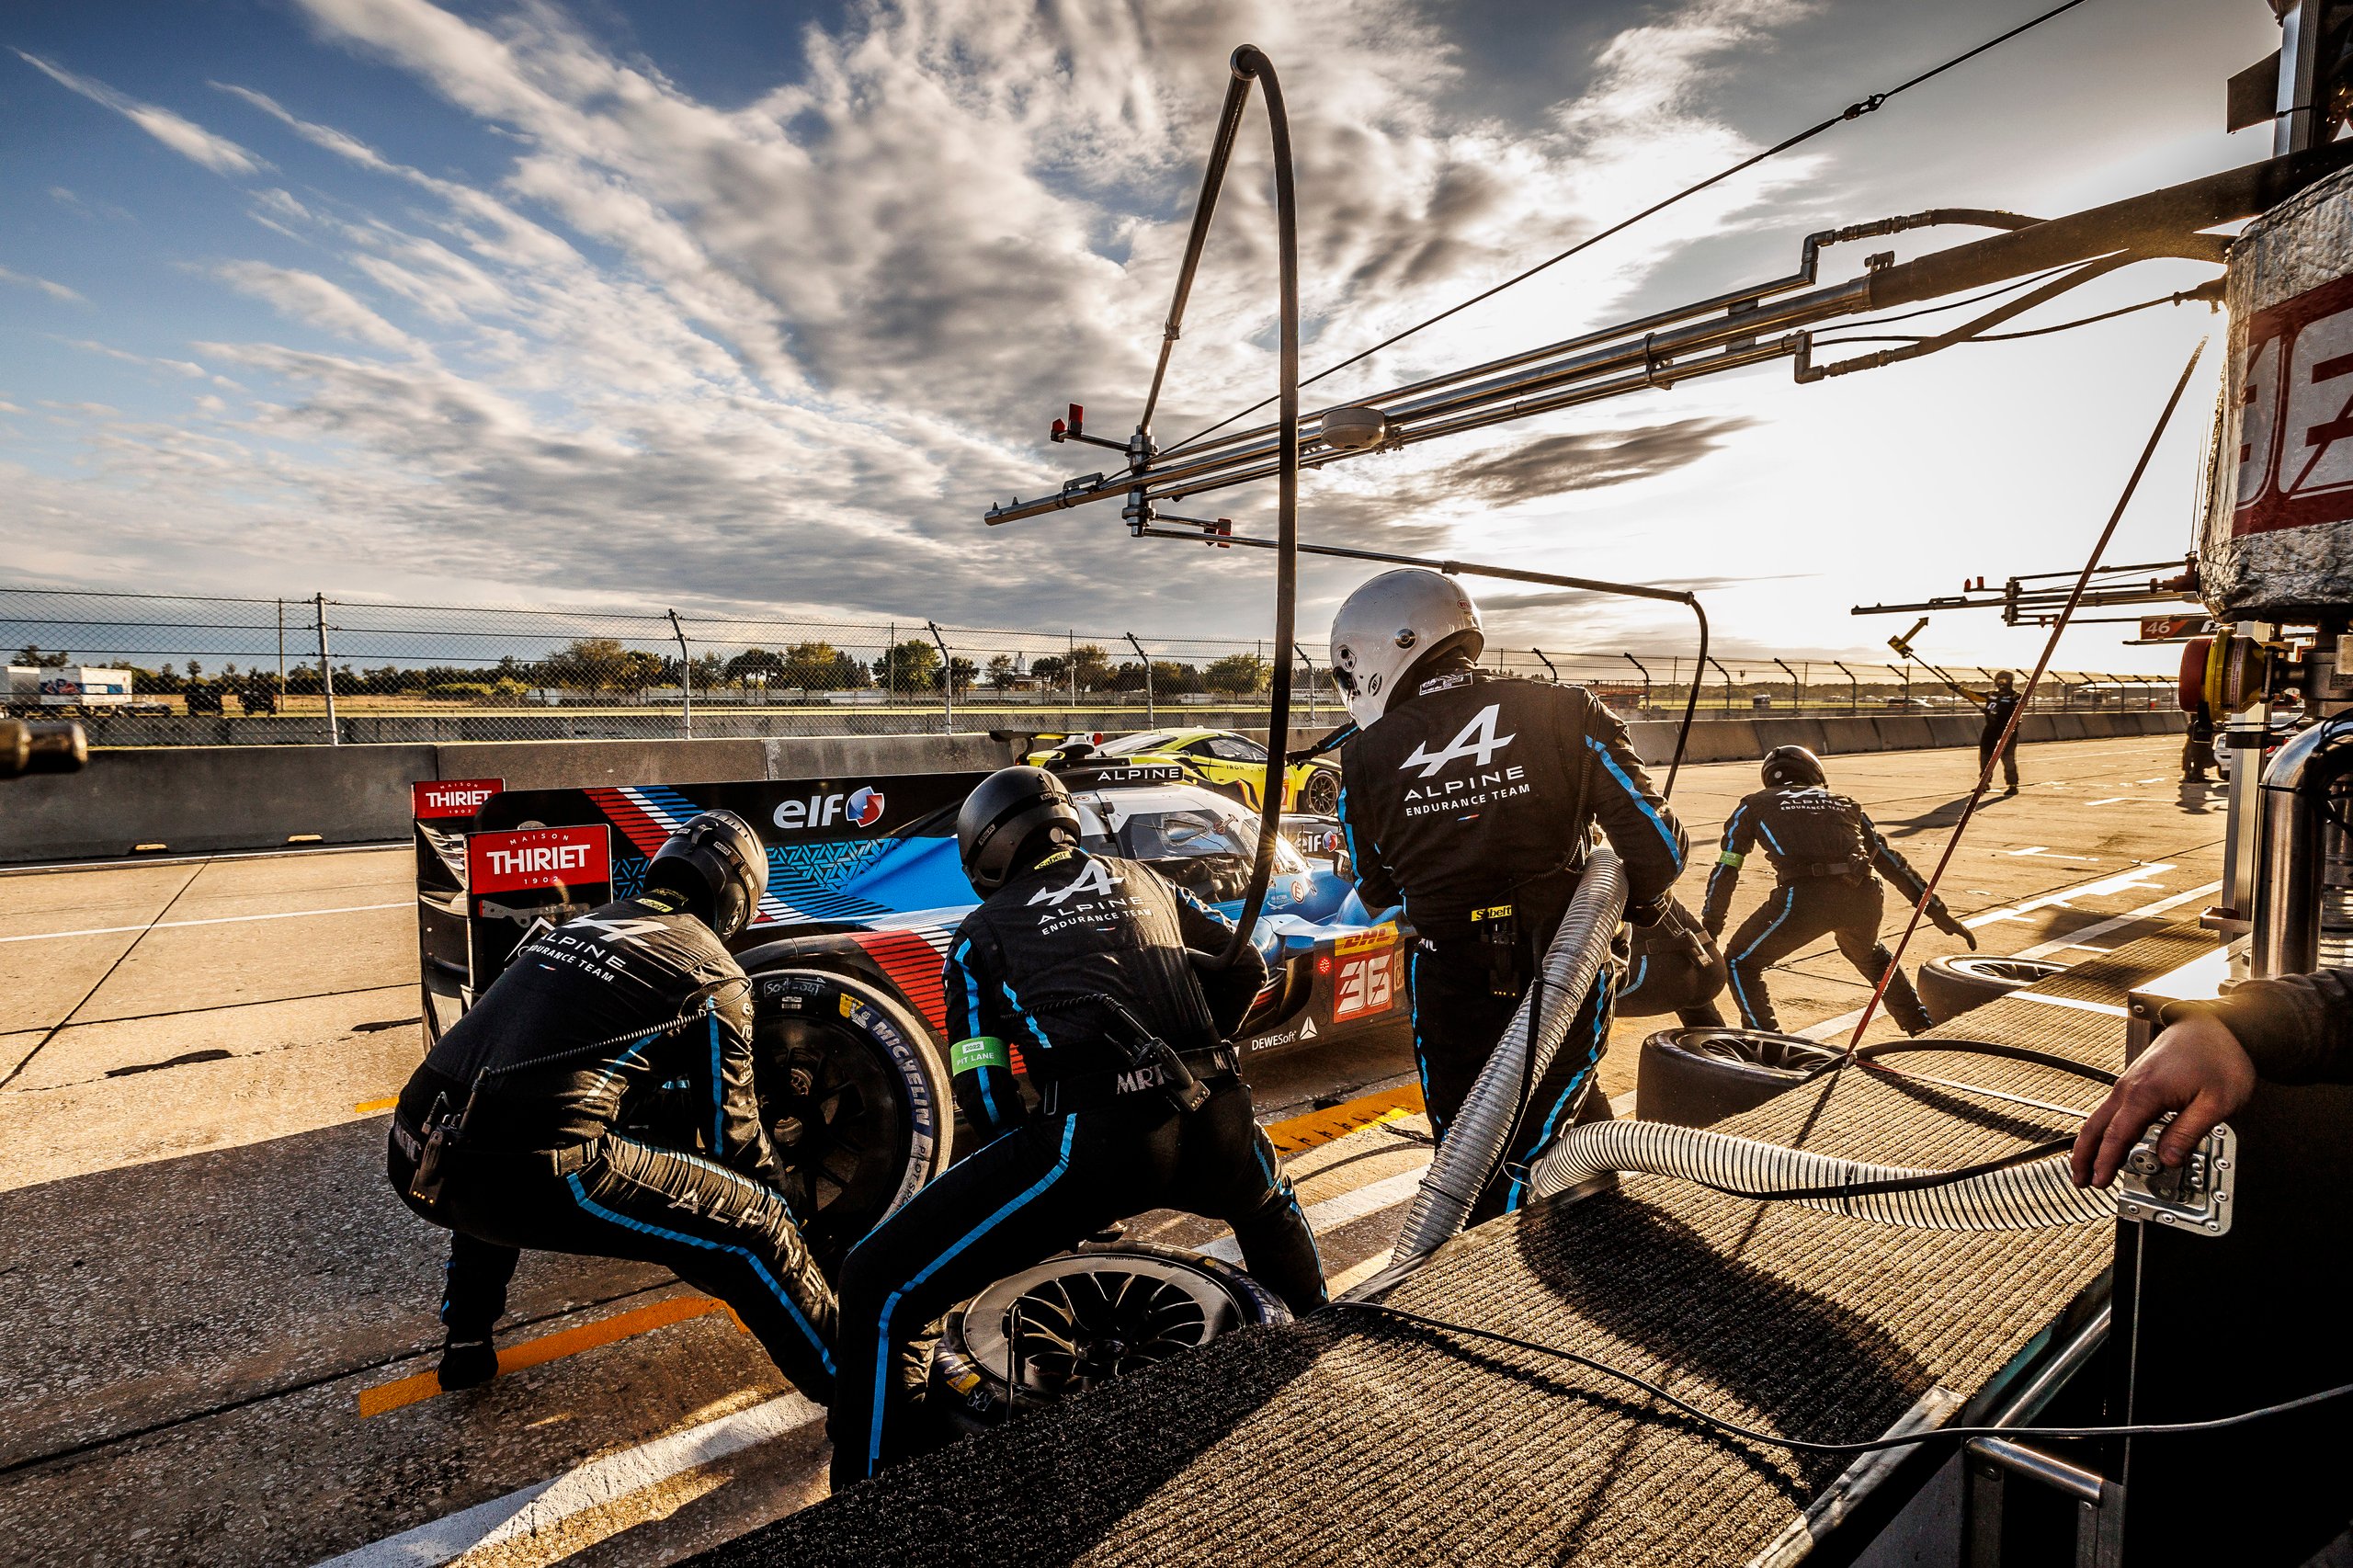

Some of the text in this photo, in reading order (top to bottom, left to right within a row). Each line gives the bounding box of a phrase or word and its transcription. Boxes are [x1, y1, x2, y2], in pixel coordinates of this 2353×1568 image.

[2145, 621, 2170, 634] 46
[1097, 768, 1179, 781] ALPINE
[1404, 766, 1525, 801] ALPINE
[426, 790, 493, 808] THIRIET
[1405, 783, 1530, 817] ENDURANCE TEAM
[1780, 799, 1847, 807] ALPINE
[773, 793, 844, 829] elf
[509, 833, 569, 846] MAISON
[1294, 834, 1322, 854] elf
[486, 844, 591, 875] THIRIET
[524, 875, 559, 885] 1902
[1037, 896, 1146, 926] ALPINE
[1476, 907, 1512, 919] Sbelt
[1041, 908, 1154, 936] ENDURANCE TEAM
[1343, 928, 1391, 949] DHL
[528, 944, 615, 983] DURANCE TEAM
[1336, 954, 1391, 1015] 36
[965, 1043, 981, 1051] 2022
[1251, 1030, 1295, 1051] DEWESoft
[957, 1052, 995, 1066] PIT LANE
[872, 1021, 930, 1126] MICHELIN
[913, 1145, 926, 1182] PILOT
